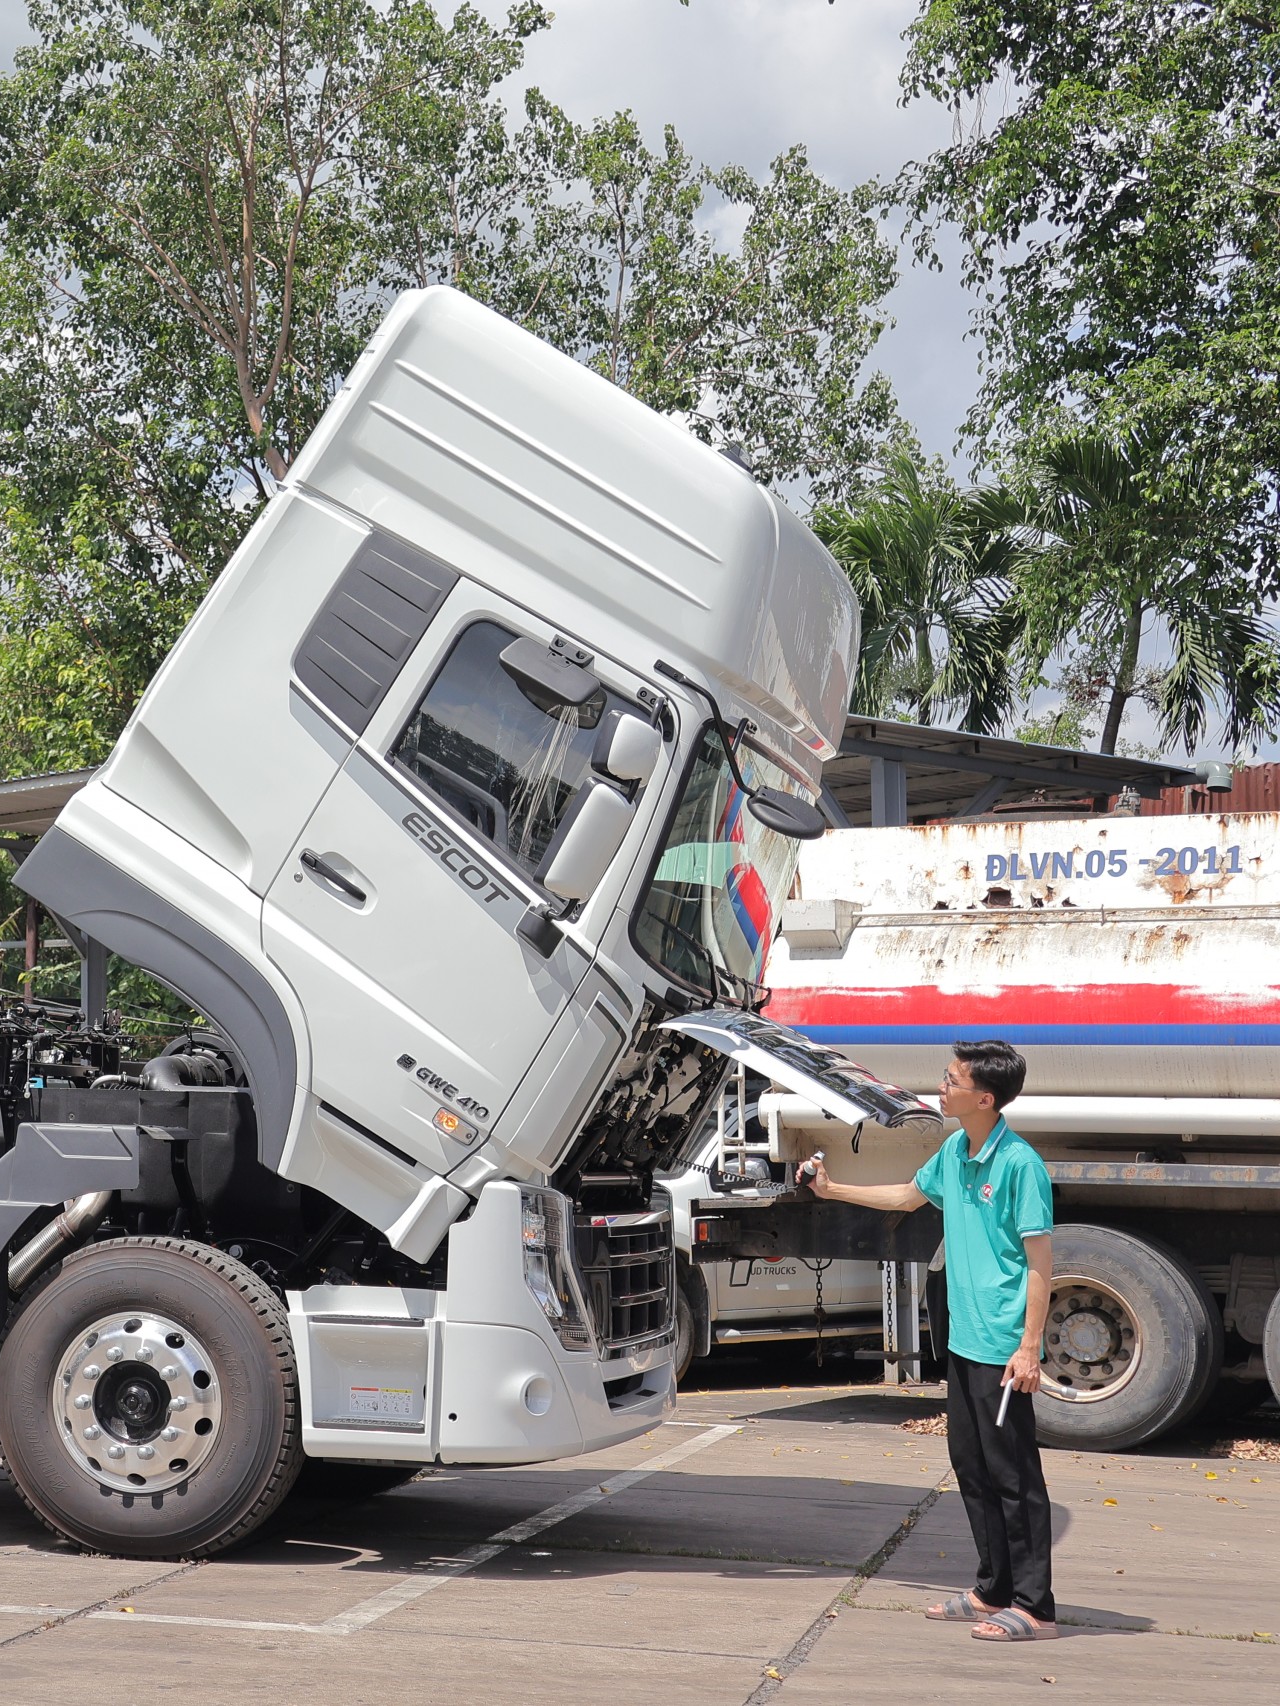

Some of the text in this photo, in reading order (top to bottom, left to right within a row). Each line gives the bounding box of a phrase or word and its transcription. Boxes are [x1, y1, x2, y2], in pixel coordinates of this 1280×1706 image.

[401, 812, 510, 904] ESCOT
[416, 1066, 490, 1124] GWE 410
[750, 1266, 797, 1276] UD TRUCKS
